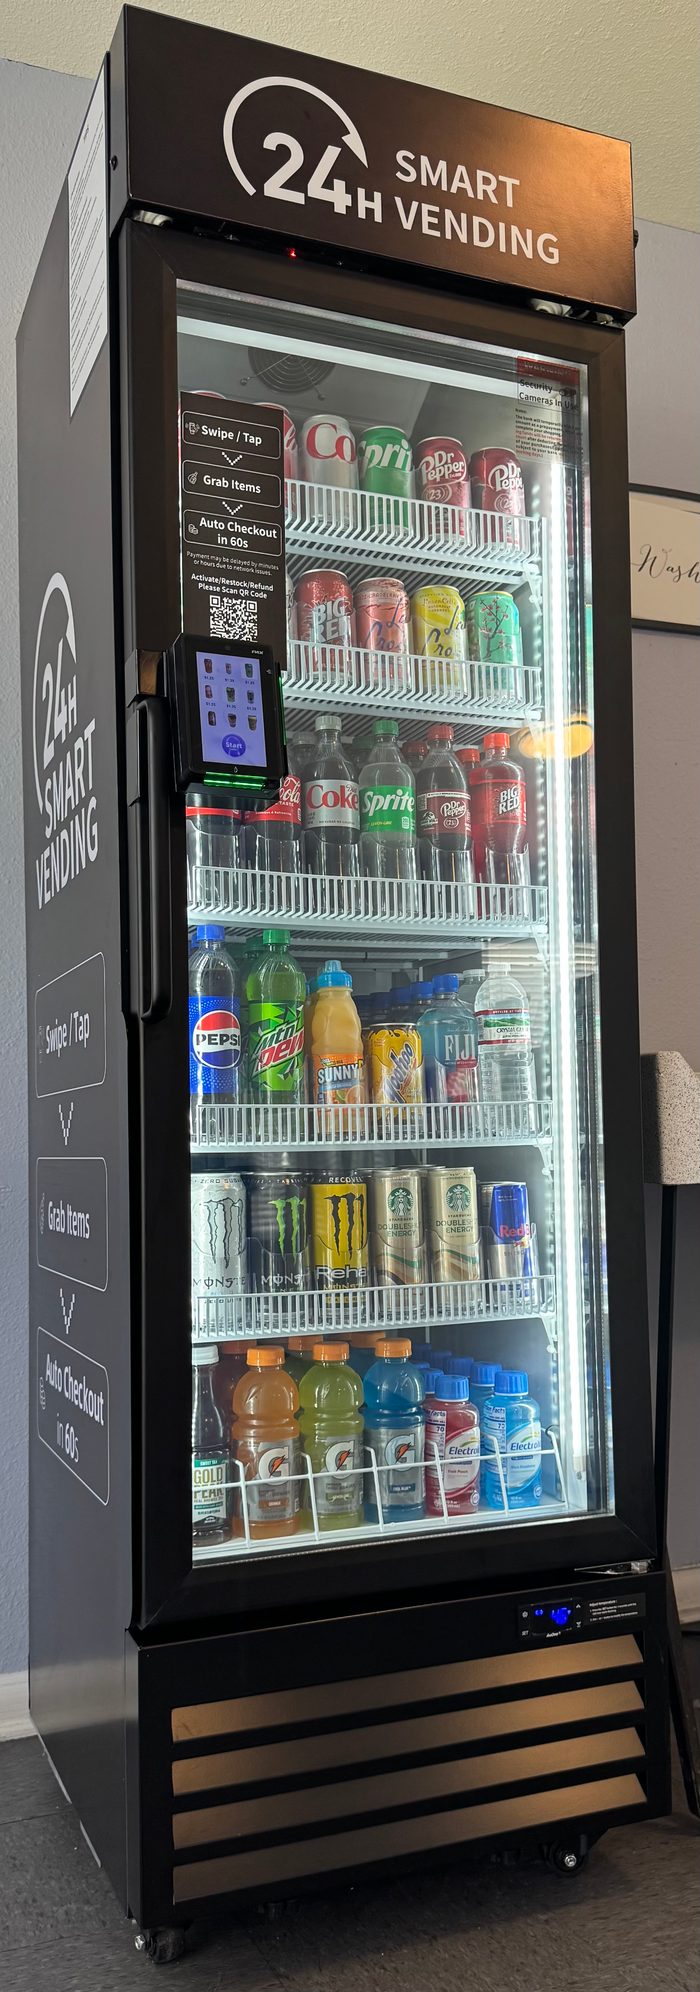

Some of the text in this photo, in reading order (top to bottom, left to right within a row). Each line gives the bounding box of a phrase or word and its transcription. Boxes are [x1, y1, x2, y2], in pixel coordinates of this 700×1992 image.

[262, 131, 382, 223] 24H
[395, 150, 520, 208] SMART
[395, 195, 560, 265] VENDING
[520, 379, 553, 394] Security
[519, 392, 554, 407] Cameras
[201, 425, 234, 442] Swipe
[242, 432, 263, 446] Tap
[306, 422, 356, 464] Co
[433, 450, 455, 467] Dr
[508, 460, 521, 478] Dr
[420, 457, 466, 485] Pepper
[203, 474, 261, 494] Grab Items
[199, 517, 278, 539] Auto Checkout
[217, 534, 249, 549] in 60s
[186, 550, 210, 560] Payment
[230, 557, 250, 566] delayed
[251, 560, 258, 568] by
[233, 565, 255, 573] network
[631, 544, 700, 584] Wash
[191, 573, 274, 592] Activate/Restock/Refund
[198, 582, 268, 599] Please Scan QR Code
[313, 597, 346, 624] BIG
[225, 741, 243, 749] Start
[44, 718, 96, 839] SMART
[306, 784, 359, 811] Coke
[362, 789, 415, 817] Sprite
[450, 800, 460, 808] Dr
[500, 785, 520, 803] BIG
[442, 802, 466, 817] Pepper
[499, 797, 520, 815] RED
[36, 796, 98, 911] VENDING
[45, 1018, 68, 1058] Swipe
[73, 1010, 90, 1048] Tap
[444, 1033, 476, 1061] FIJI
[48, 1200, 90, 1239] Grab Items
[446, 1226, 474, 1234] ENERGY
[388, 1229, 417, 1237] ENERGY
[193, 1275, 246, 1289] MONSTE
[315, 1265, 367, 1282] Reha
[45, 1353, 104, 1426] Auto Checkout
[56, 1412, 79, 1463] in 60s
[325, 1440, 354, 1480] G
[385, 1433, 416, 1472] G
[194, 1467, 223, 1485] GOLD
[258, 1447, 290, 1486] G
